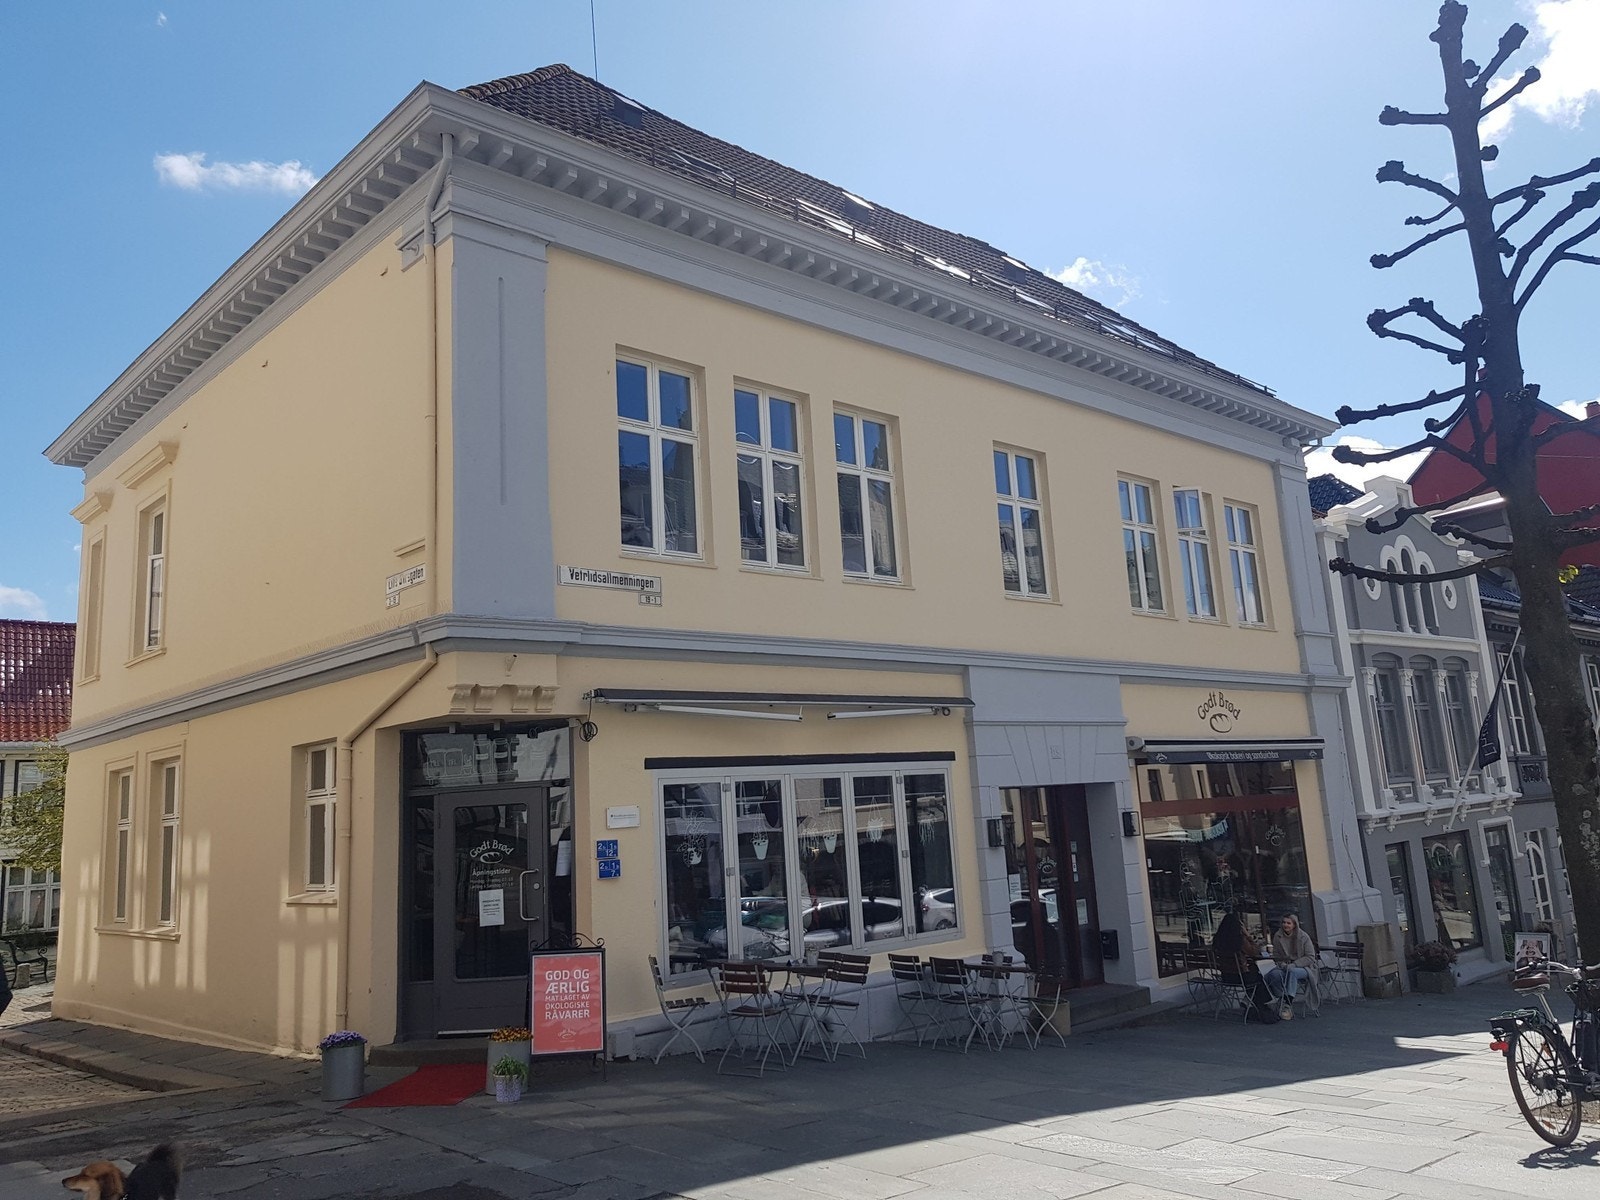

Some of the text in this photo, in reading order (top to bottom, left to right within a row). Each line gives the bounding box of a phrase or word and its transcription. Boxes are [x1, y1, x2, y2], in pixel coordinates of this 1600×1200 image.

[569, 568, 654, 590] Vetrlidsallmenningen
[1198, 691, 1241, 720] Godt Brød
[470, 840, 514, 857] Godt Brød
[545, 969, 590, 981] GOD OG
[545, 981, 590, 994] ÆRLIG
[545, 1001, 590, 1010] ØKOLOGISKE
[545, 1009, 590, 1020] RÅVARER
